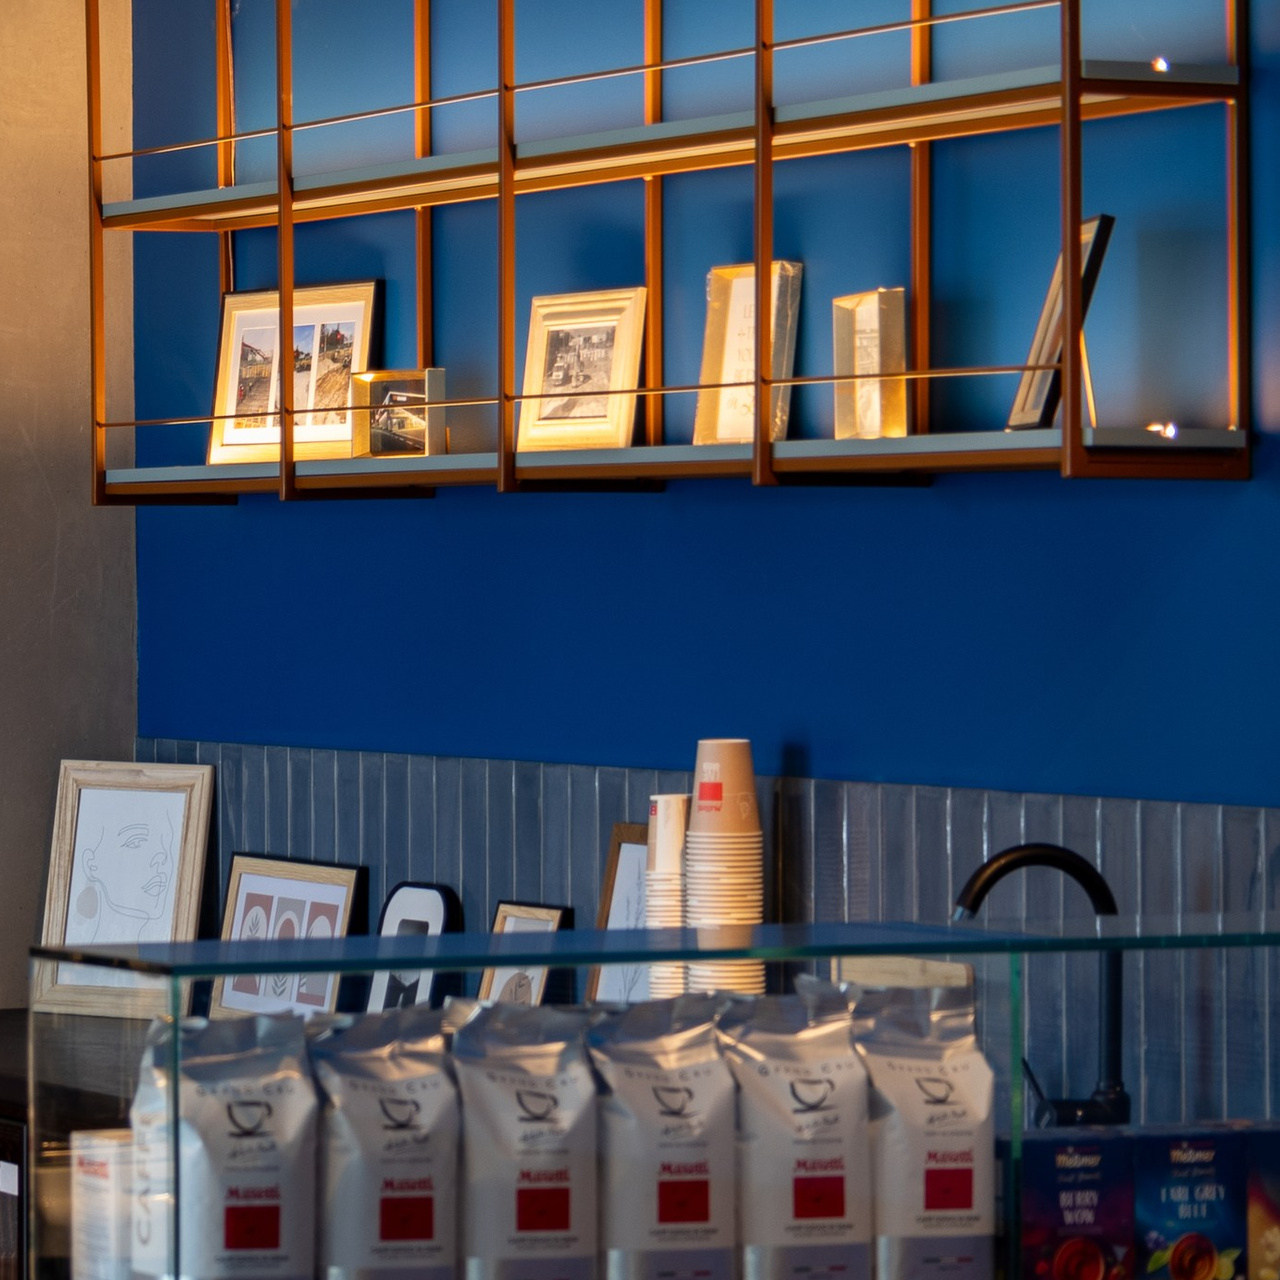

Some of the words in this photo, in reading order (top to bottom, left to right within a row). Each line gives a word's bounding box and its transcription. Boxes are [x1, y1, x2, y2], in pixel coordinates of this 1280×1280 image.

[1059, 1190, 1099, 1208] BERRY
[1193, 1184, 1226, 1201] GREY
[1063, 1208, 1095, 1225] WOW
